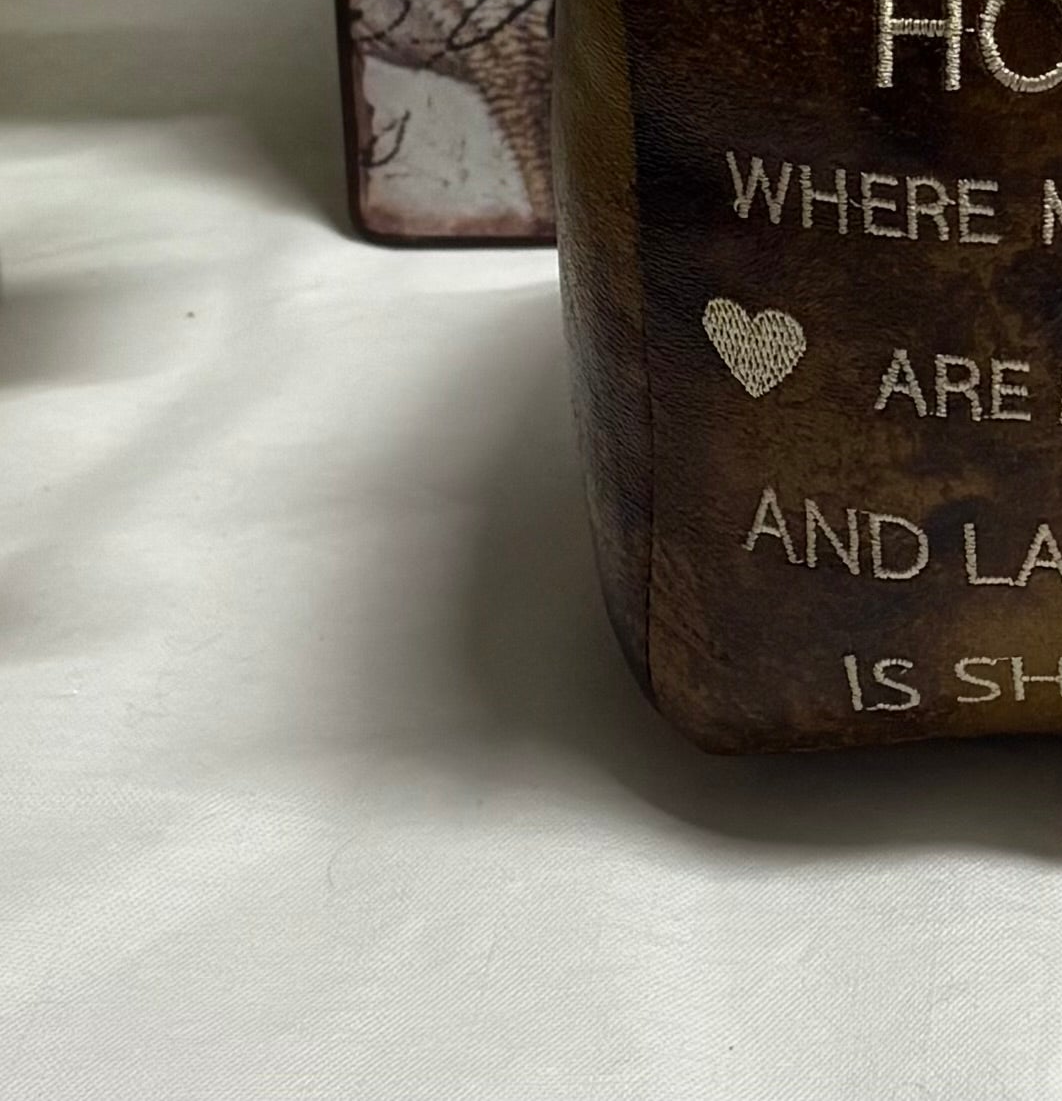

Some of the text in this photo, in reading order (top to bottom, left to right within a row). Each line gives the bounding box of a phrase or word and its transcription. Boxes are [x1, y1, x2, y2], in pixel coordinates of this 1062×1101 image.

[725, 151, 1001, 244] WHERE
[873, 348, 1032, 423] ARE
[741, 488, 930, 580] AND
[842, 653, 921, 712] IS
